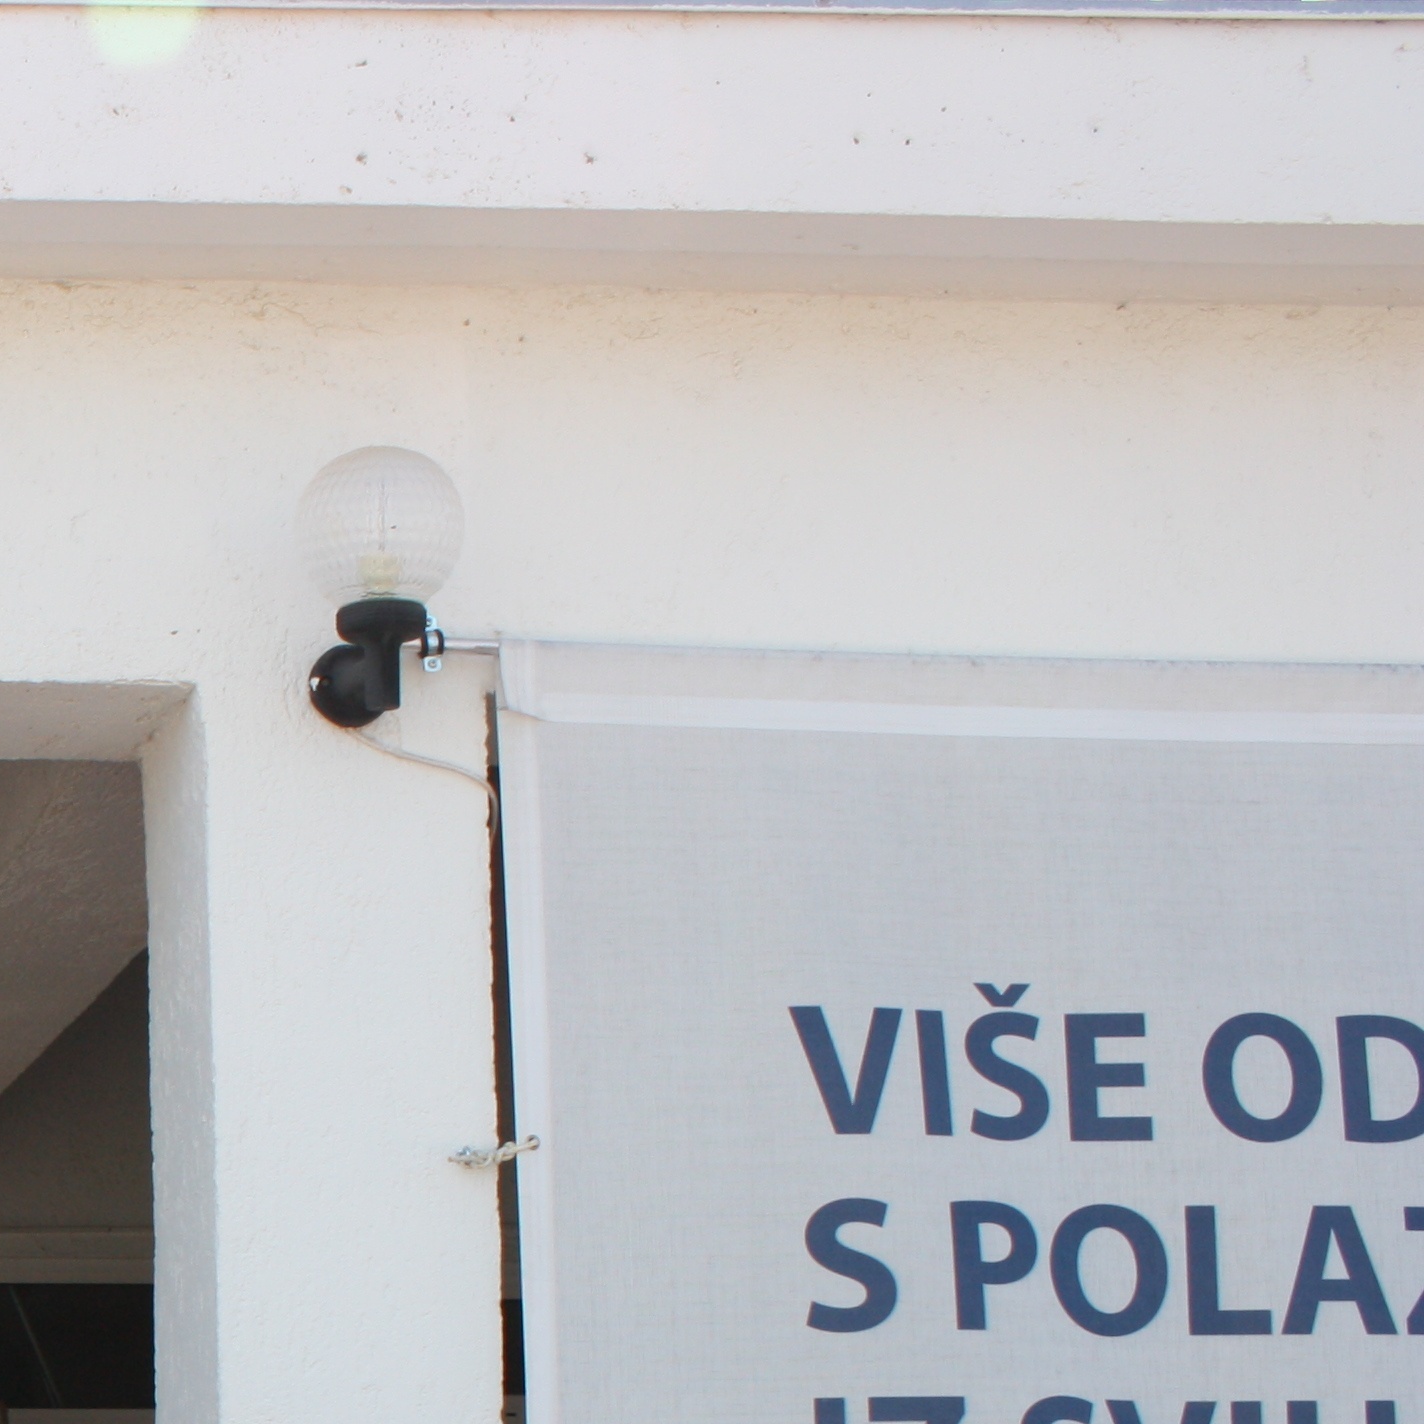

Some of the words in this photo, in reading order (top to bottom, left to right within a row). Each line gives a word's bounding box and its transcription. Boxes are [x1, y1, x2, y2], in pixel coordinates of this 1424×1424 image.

[788, 982, 1155, 1143] VIŠE
[1201, 1011, 1424, 1144] OD
[803, 1197, 900, 1333] S
